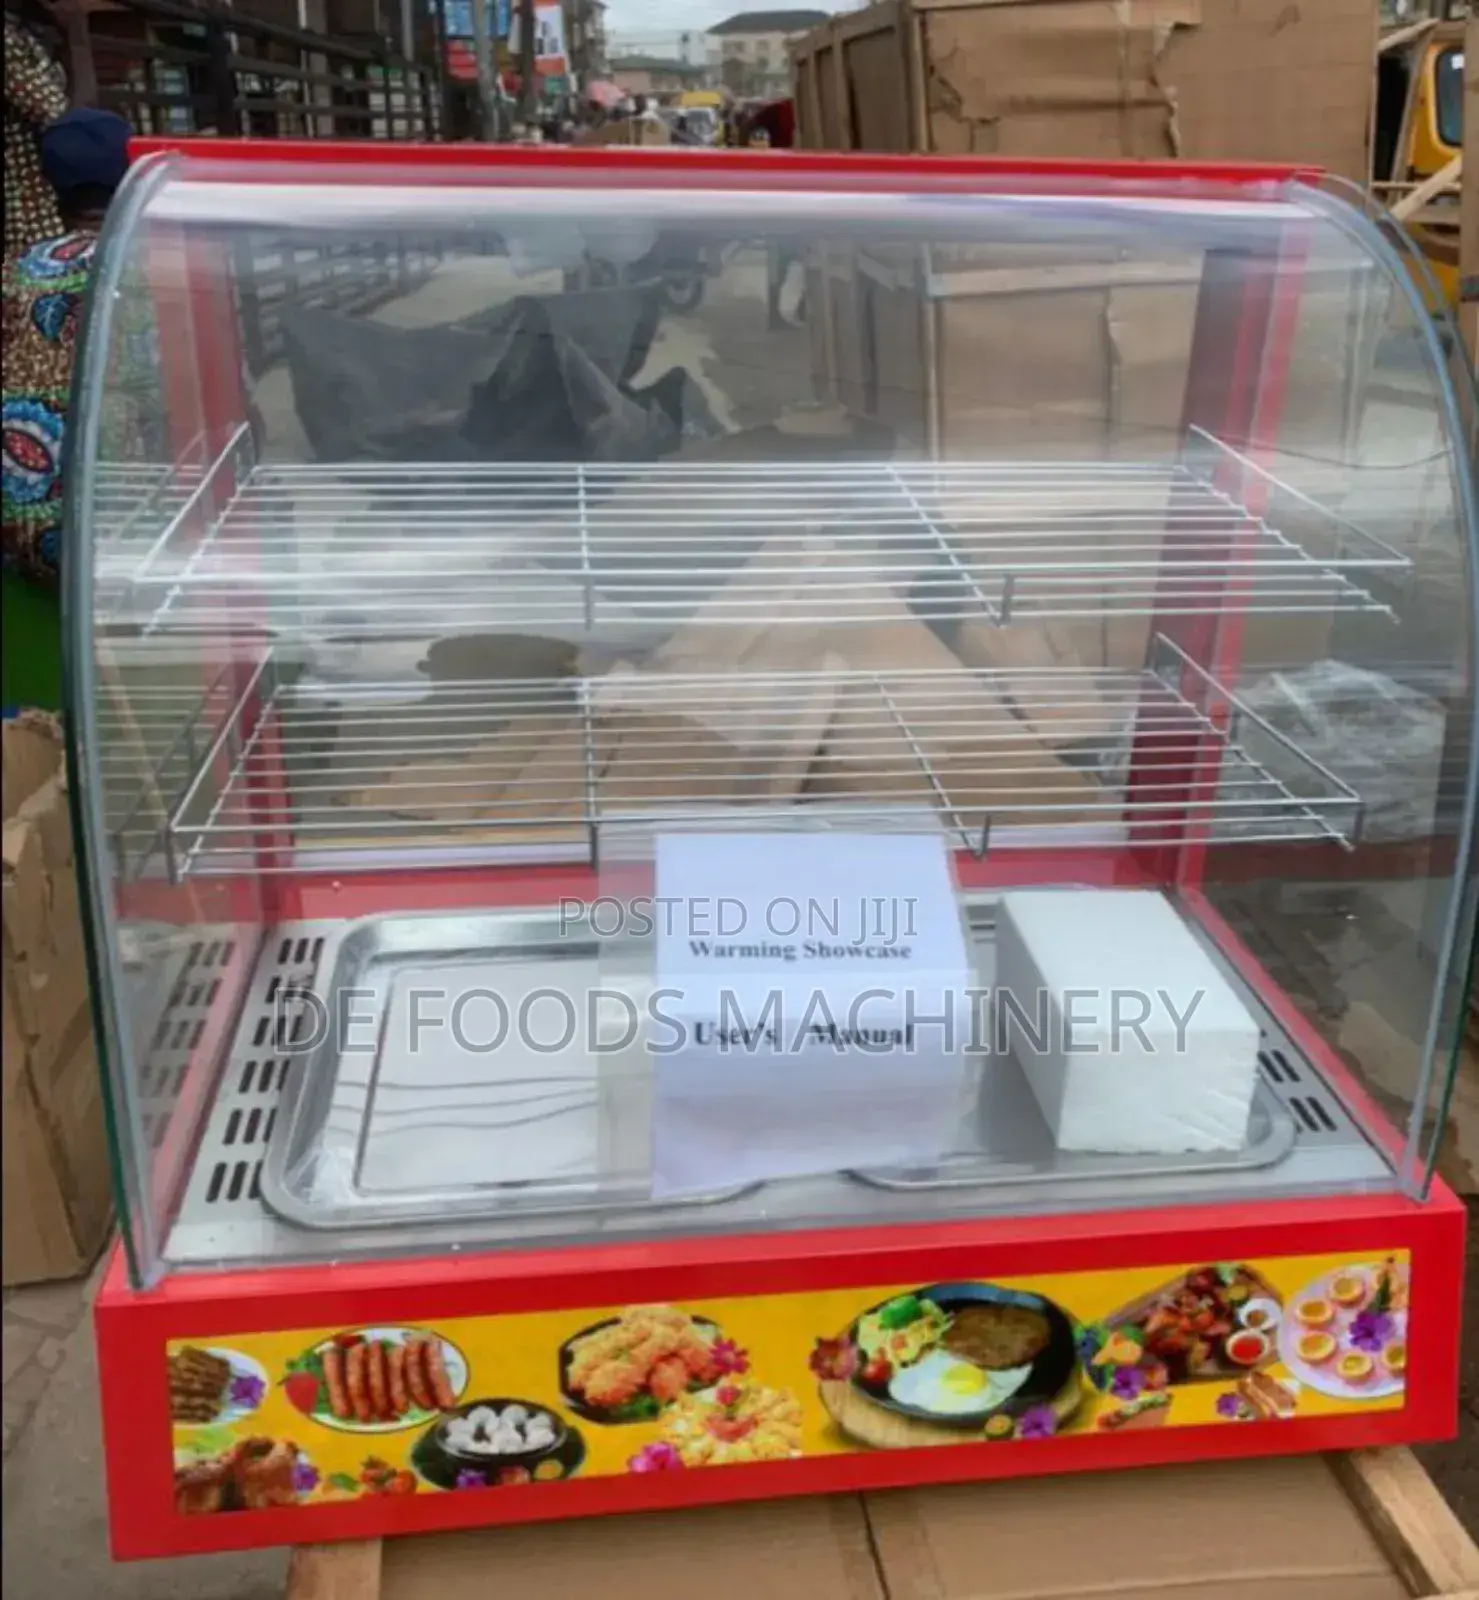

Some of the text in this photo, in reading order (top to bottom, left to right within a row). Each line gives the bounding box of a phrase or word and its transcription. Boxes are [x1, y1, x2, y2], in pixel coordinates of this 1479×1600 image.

[688, 939, 912, 961] Warming Showcase
[694, 1021, 915, 1047] User's Manual
